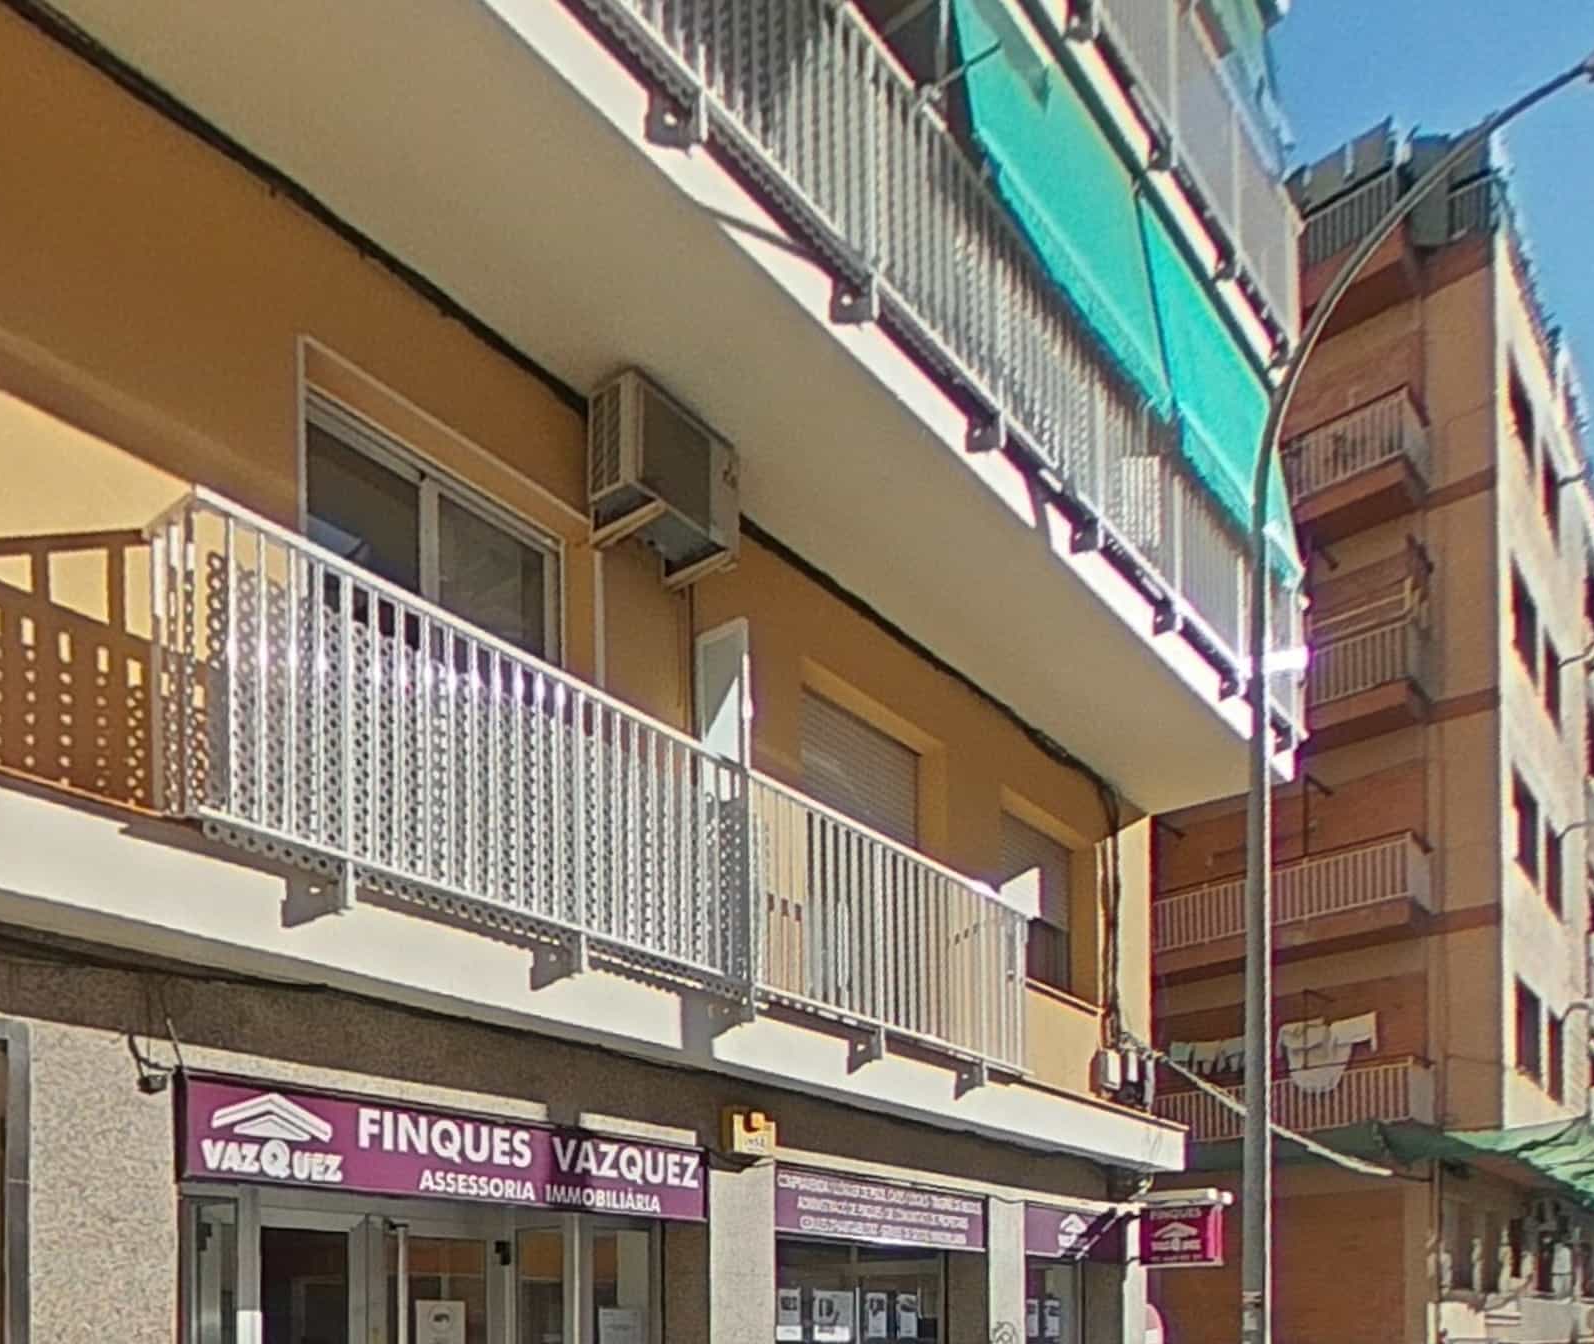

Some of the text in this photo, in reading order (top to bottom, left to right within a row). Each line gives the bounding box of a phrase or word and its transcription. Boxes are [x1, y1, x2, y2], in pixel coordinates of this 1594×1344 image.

[201, 1138, 344, 1183] VAZQUEZ
[357, 1107, 700, 1189] FINQUES VAZQUEZ
[419, 1169, 536, 1201] ASSESSORIA
